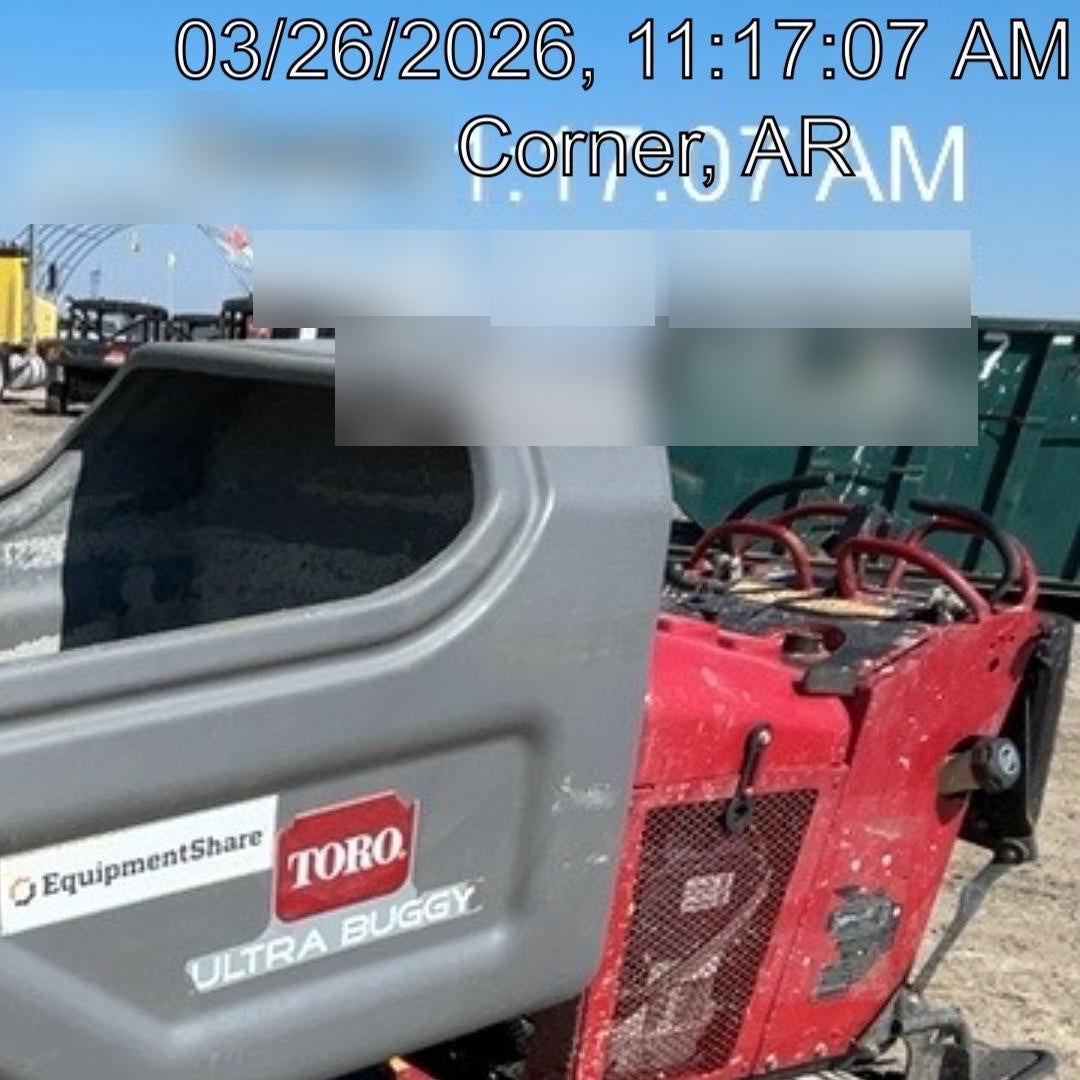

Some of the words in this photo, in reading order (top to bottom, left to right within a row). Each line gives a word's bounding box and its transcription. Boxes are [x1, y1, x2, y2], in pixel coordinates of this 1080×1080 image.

[41, 829, 263, 897] EquipmentShare
[287, 826, 405, 889] TORO
[189, 928, 328, 991] ULTRA
[341, 883, 478, 947] BUGGY
